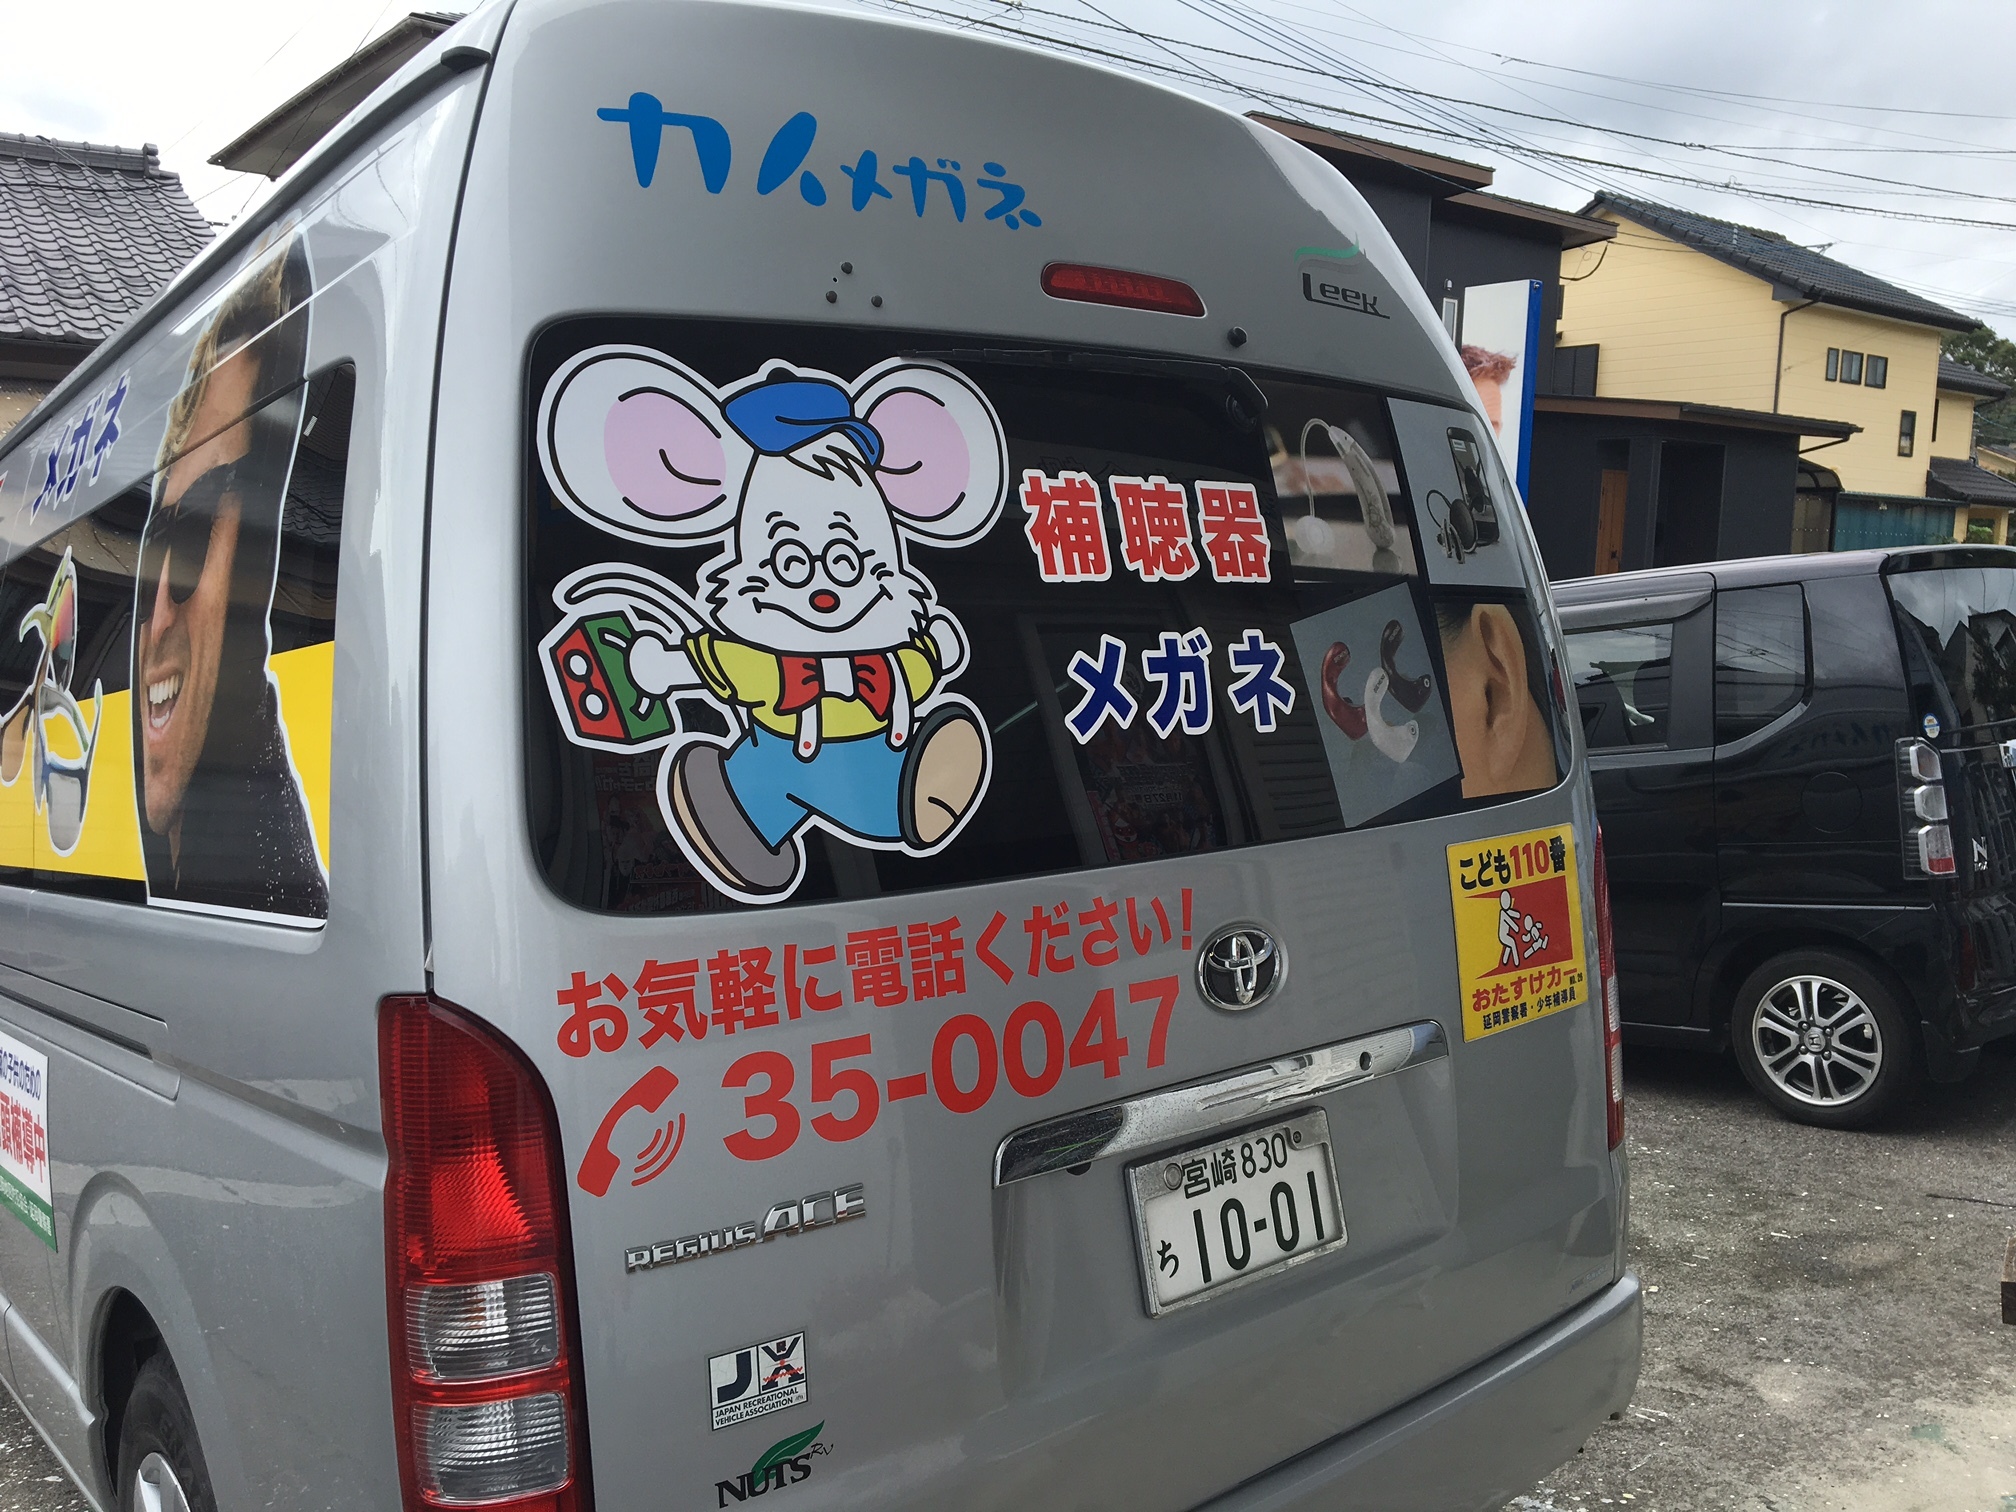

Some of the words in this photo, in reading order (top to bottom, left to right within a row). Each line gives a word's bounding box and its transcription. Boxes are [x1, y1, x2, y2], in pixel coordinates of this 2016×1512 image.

[1302, 272, 1390, 319] Leek
[30, 368, 130, 526] メガネ
[1020, 469, 1270, 582] 補聴器
[1065, 627, 1295, 744] メガネ
[1459, 835, 1566, 890] こども110番
[556, 888, 1194, 1058] お気軽に電話ください!
[1472, 966, 1577, 1012] おたすけカー
[721, 975, 1181, 1161] 35-0047
[1182, 1148, 1237, 1199] 宮崎
[1241, 1133, 1288, 1179] 830
[1157, 1240, 1179, 1278] ち
[1193, 1171, 1324, 1283] 10-01
[715, 1403, 741, 1418] JAPAN
[743, 1387, 798, 1410] RECREATIONAL
[715, 1412, 744, 1426] VEHICLE
[745, 1397, 793, 1418] ASSOCIATION
[715, 1453, 811, 1508] NUTS
